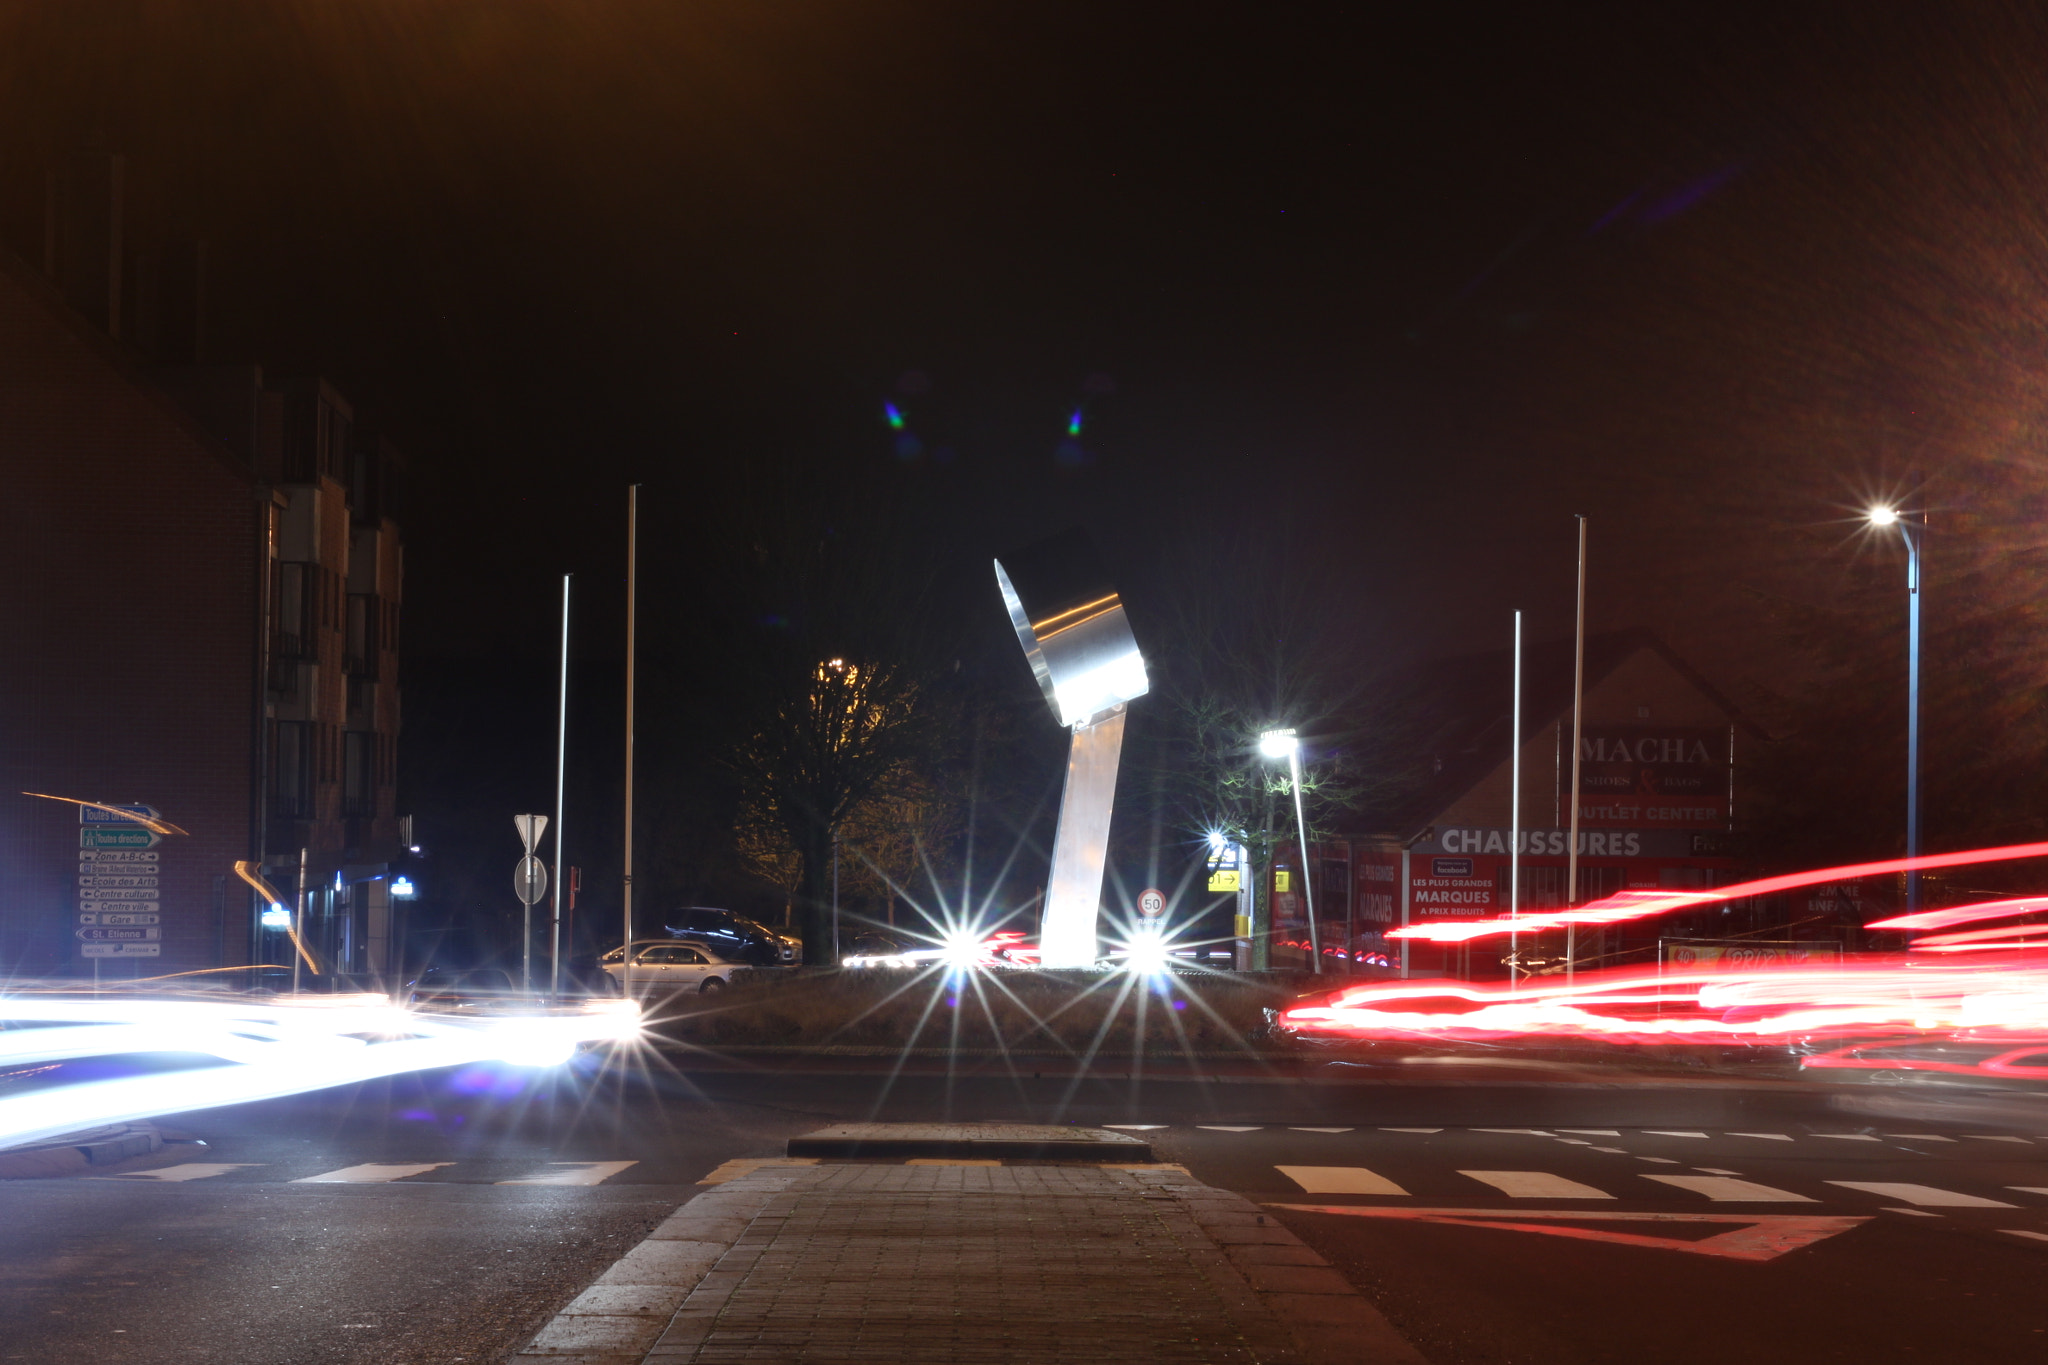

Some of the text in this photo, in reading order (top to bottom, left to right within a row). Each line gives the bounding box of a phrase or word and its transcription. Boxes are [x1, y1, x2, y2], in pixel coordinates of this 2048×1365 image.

[1580, 737, 1710, 763] MACHA
[86, 808, 110, 821] Toutes
[1646, 807, 1718, 820] CENTER
[97, 833, 148, 844] Toutes directions
[1441, 829, 1641, 856] CHAUSSURES
[95, 852, 146, 861] Zone A-B-C
[1437, 866, 1468, 874] facebook
[92, 877, 156, 885] Ecole des Arts
[1413, 879, 1493, 887] LES PLUS GRANDES
[93, 890, 155, 898] Centre culturel
[1415, 891, 1490, 904] MARQUES
[101, 902, 149, 911] Centre ville
[1145, 898, 1161, 909] 50
[1450, 908, 1485, 916] REDUITS
[110, 915, 131, 924] Gare
